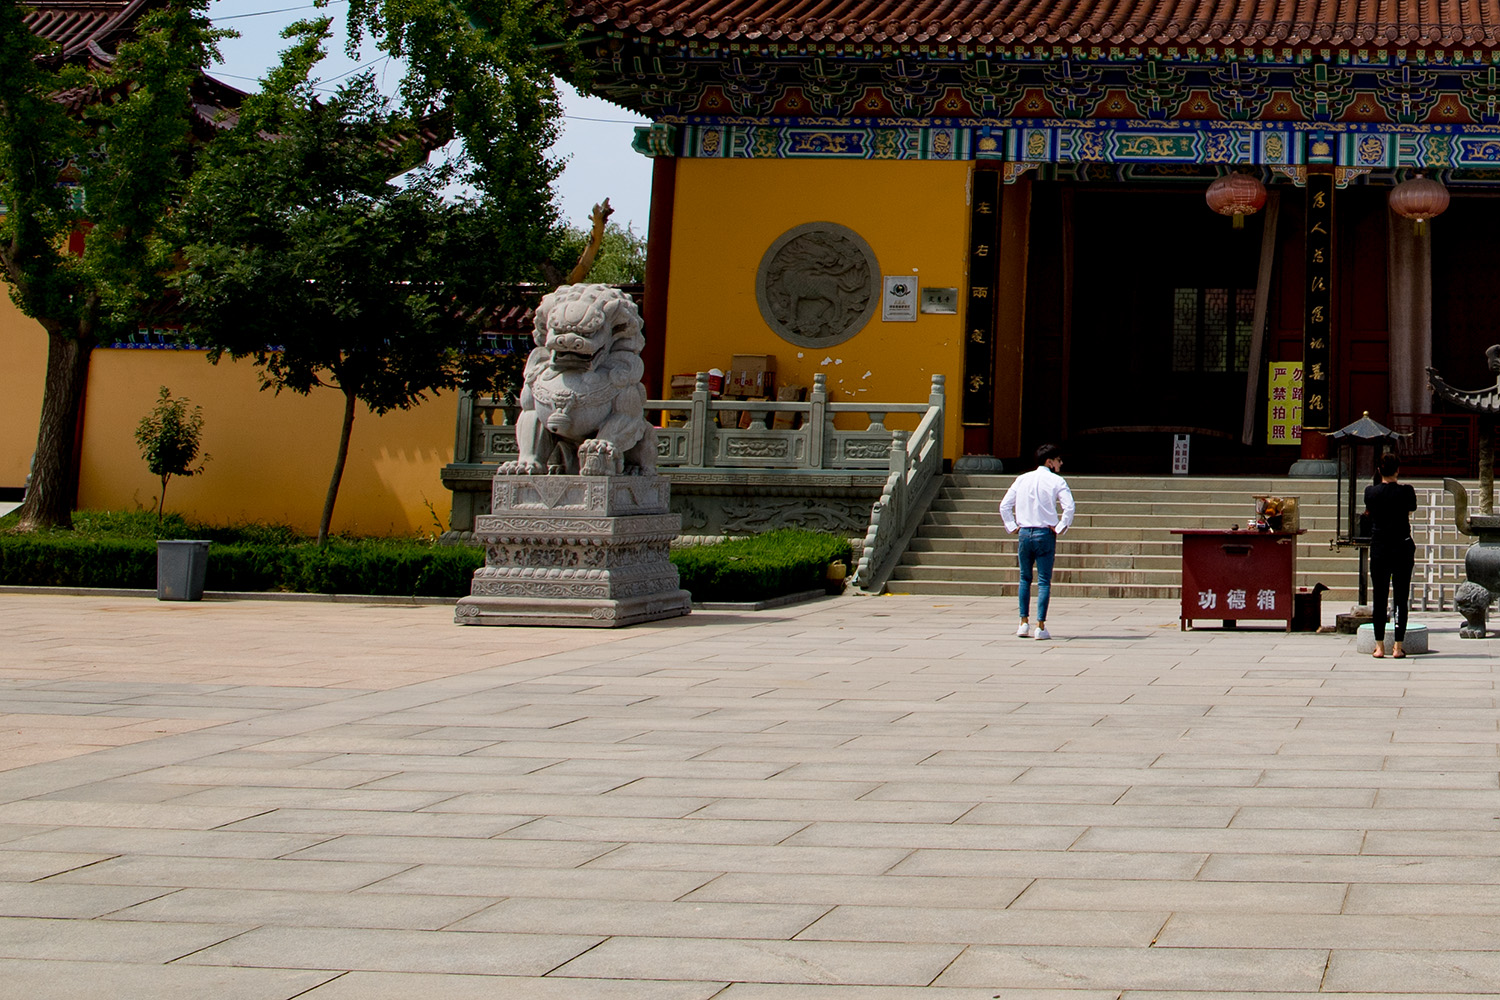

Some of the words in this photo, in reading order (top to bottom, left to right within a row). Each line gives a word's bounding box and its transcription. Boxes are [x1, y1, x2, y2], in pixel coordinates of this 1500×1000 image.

[1272, 368, 1287, 438] 严禁拍照
[1198, 588, 1276, 610] 功德箱
